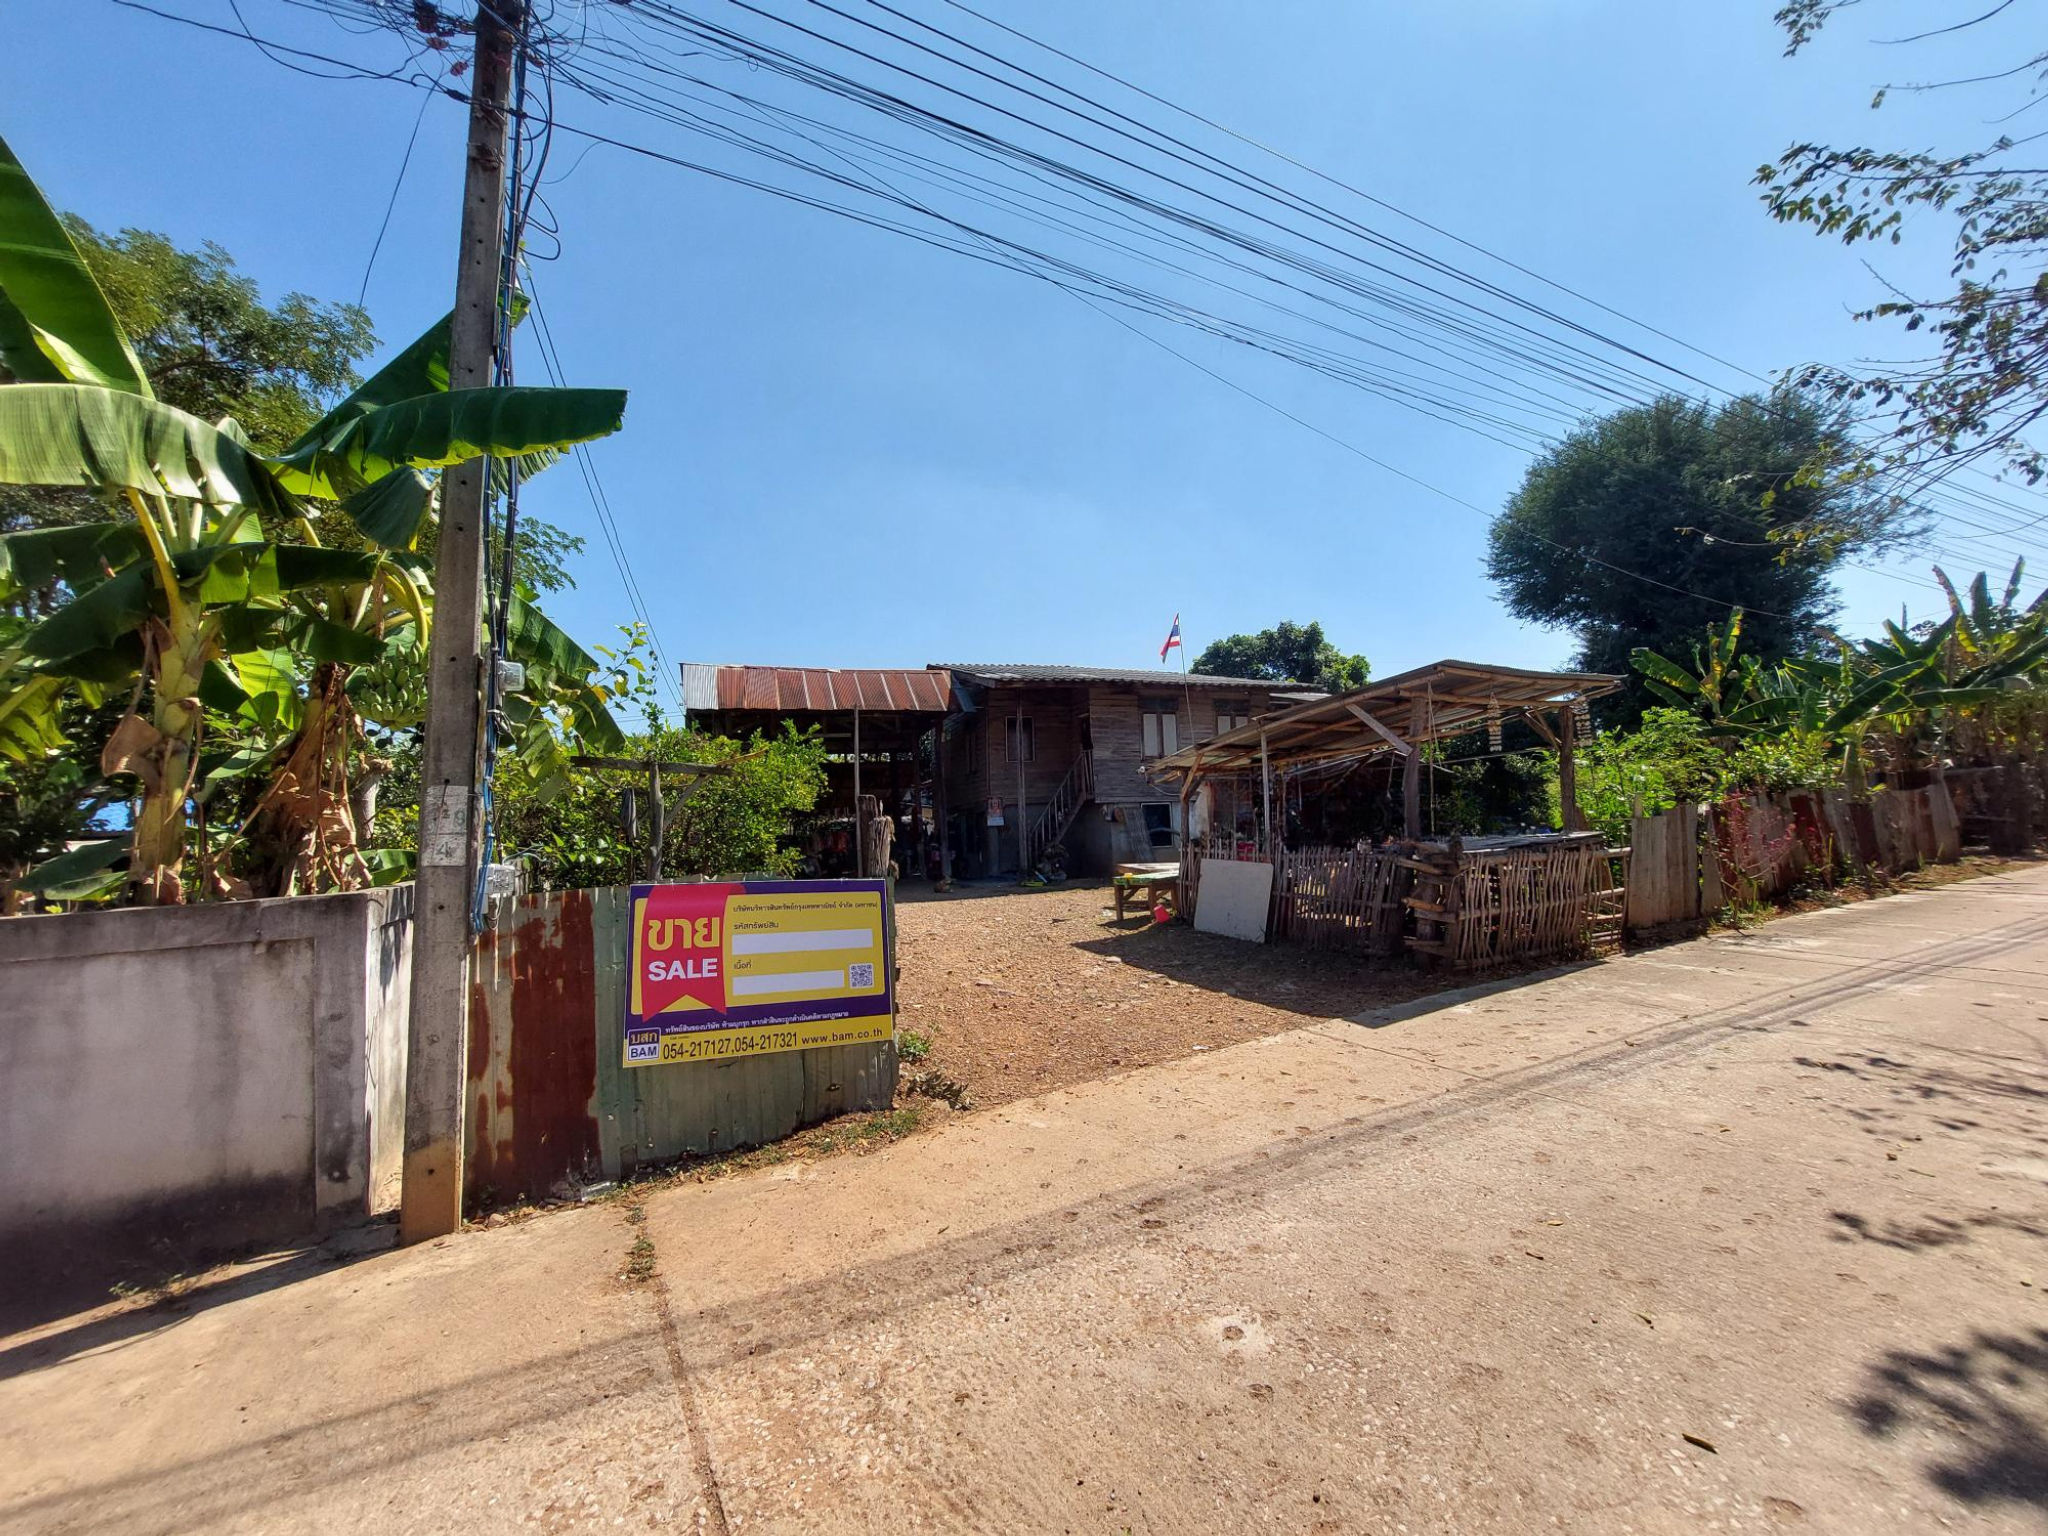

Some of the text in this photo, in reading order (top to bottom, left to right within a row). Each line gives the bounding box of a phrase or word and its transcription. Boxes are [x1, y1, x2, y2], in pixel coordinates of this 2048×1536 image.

[648, 917, 720, 951] ขาย
[648, 958, 718, 982] SALE
[801, 1027, 883, 1045] www.bam.co.th
[630, 1046, 657, 1058] BAM
